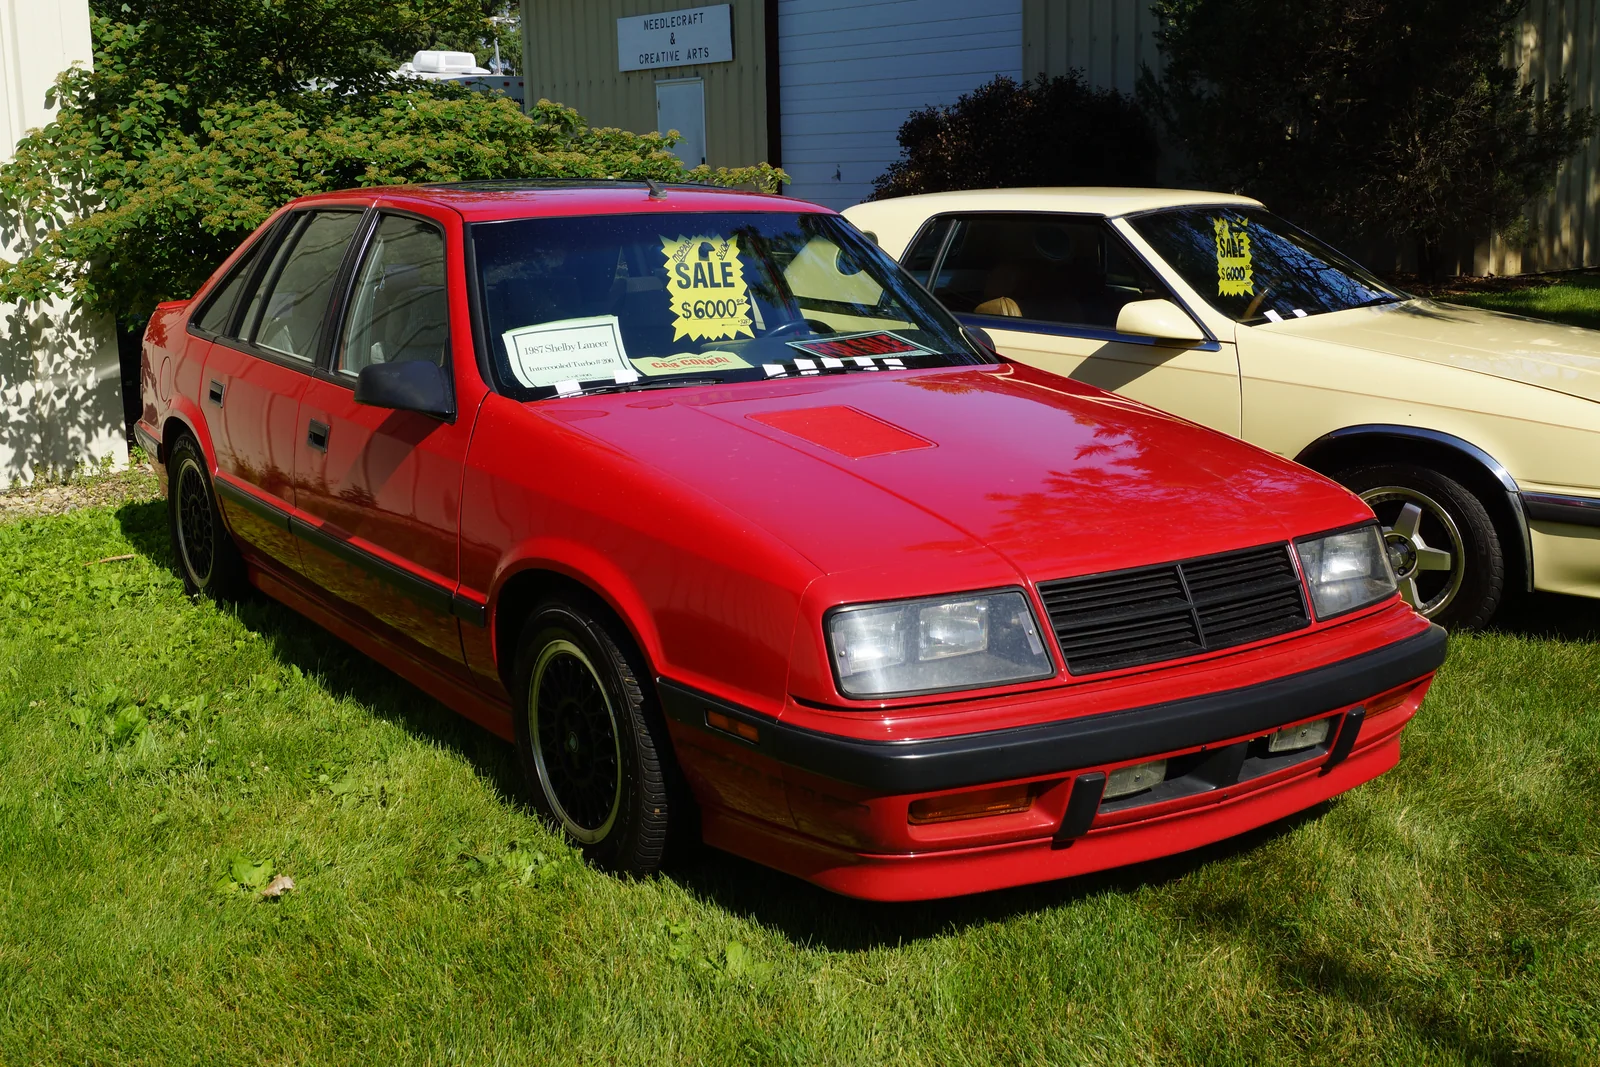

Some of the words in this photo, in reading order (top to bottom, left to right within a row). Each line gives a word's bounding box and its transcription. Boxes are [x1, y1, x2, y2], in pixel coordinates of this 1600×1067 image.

[643, 12, 704, 31] NEEDLECRAFT
[669, 32, 676, 45] &
[639, 50, 680, 64] CREATIVE
[686, 47, 710, 60] ARTS
[672, 240, 693, 263] MOPAR
[1219, 238, 1246, 258] SALE
[675, 262, 735, 289] SALE
[1221, 266, 1246, 281] $6000
[681, 299, 737, 321] $6000
[524, 345, 544, 355] 1987
[545, 342, 576, 353] Shelby
[578, 340, 609, 350] Lancer
[528, 362, 571, 372] Intercooled
[571, 360, 596, 368] Turbo
[651, 361, 681, 369] CAR
[680, 356, 731, 366] CORRAL
